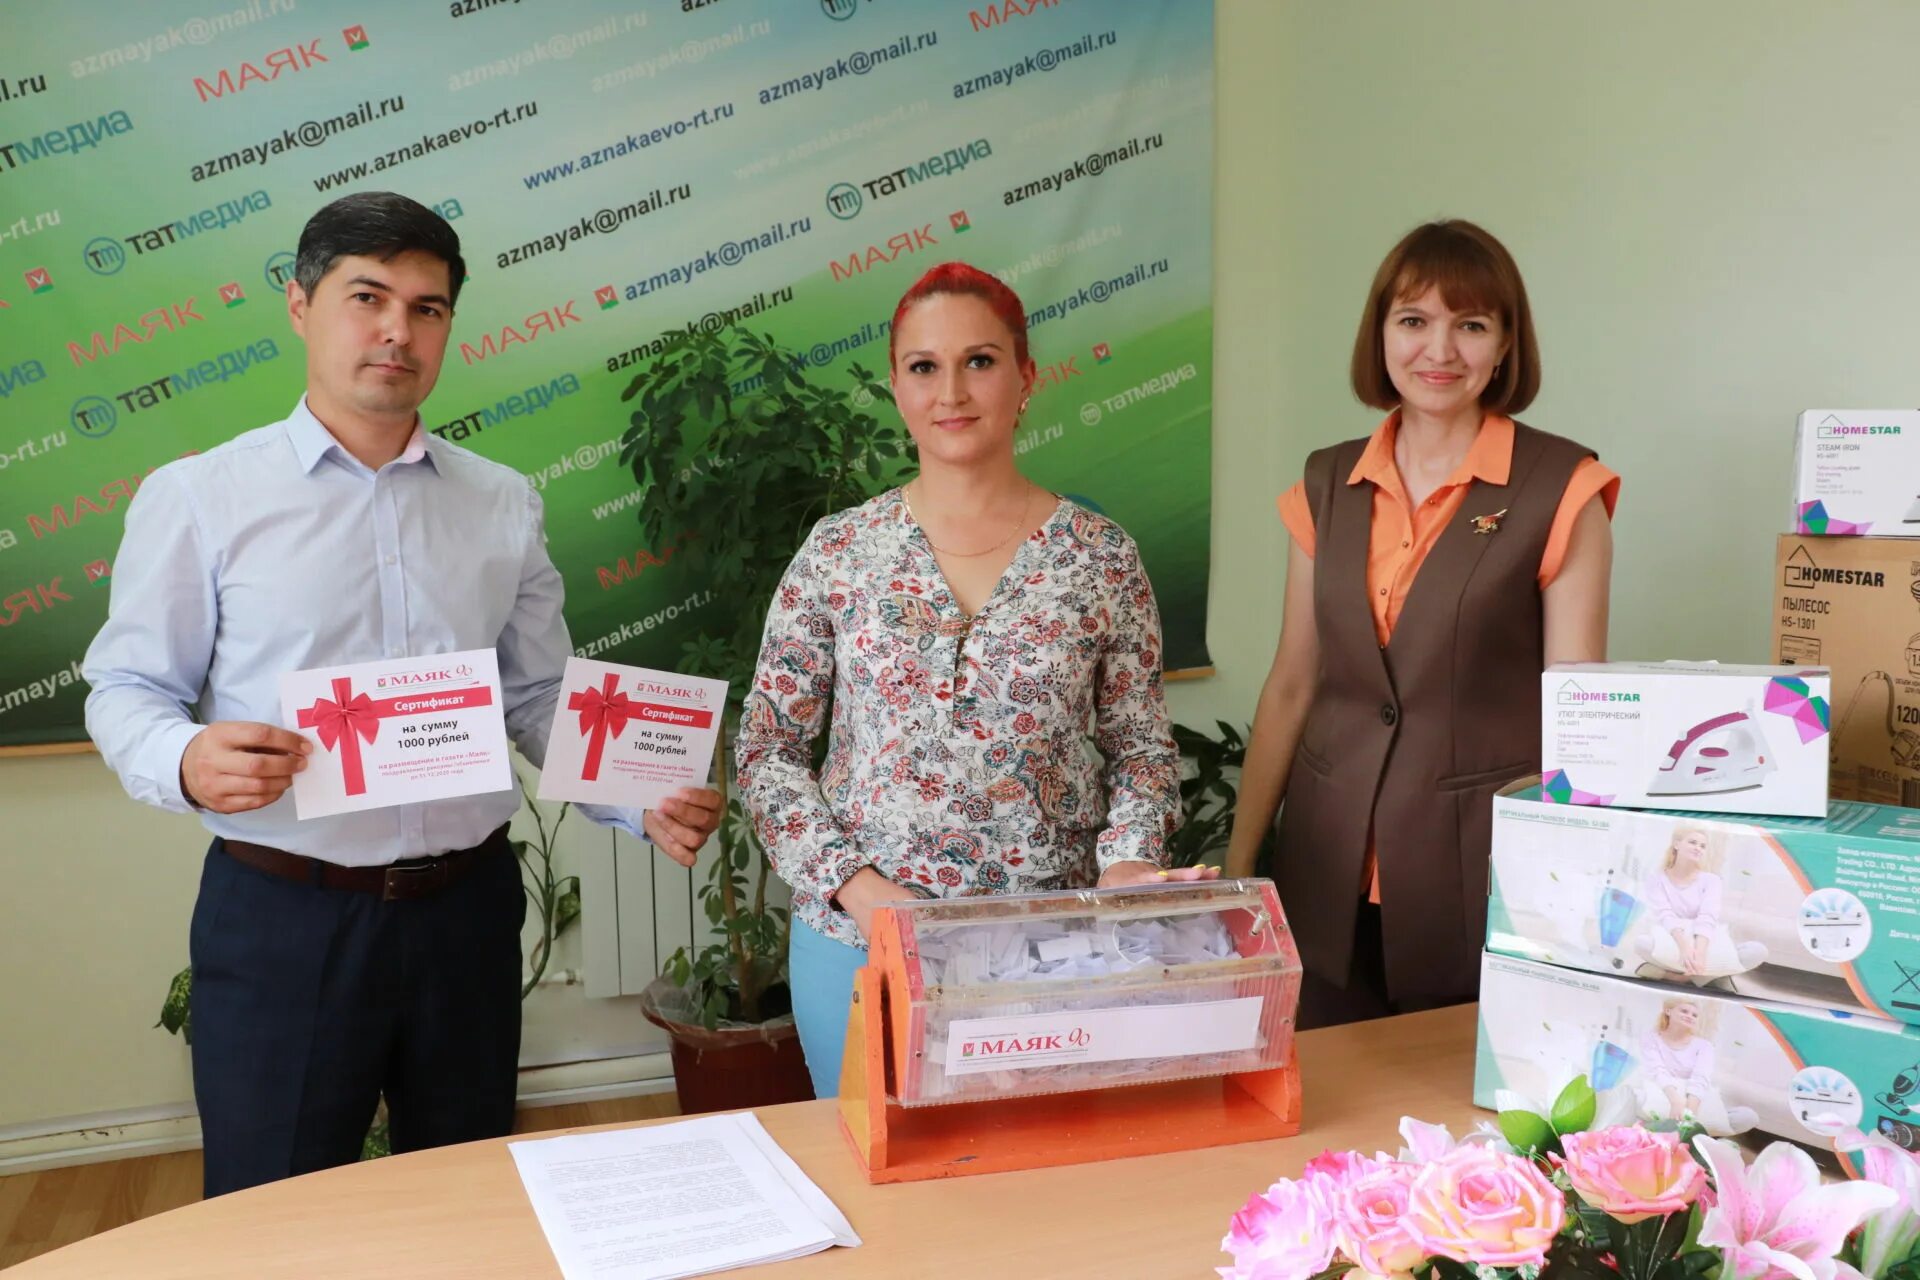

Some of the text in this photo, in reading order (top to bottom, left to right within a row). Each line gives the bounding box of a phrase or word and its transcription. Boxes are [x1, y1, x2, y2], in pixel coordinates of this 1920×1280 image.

[193, 38, 329, 102] МАЯК
[759, 31, 937, 104] azmayak@mail.ru
[953, 29, 1117, 99] azmayak@mail.ru
[191, 96, 404, 182] azmayak@mail.ru
[314, 101, 538, 192] www.aznakaevo-rt.ru
[523, 102, 734, 190] www.aznakaevo-rt.ru
[1003, 134, 1163, 207] azmayak@mail.ru
[496, 182, 692, 269] azmayak@mail.ru
[624, 217, 813, 301] azmayak@mail.ru
[829, 223, 939, 282] МАЯК
[66, 297, 205, 368] МАЯК
[460, 300, 582, 366] МАЯК
[1833, 426, 1901, 434] HOMESTAR
[1802, 567, 1885, 587] HOMESTAR
[1783, 597, 1831, 614] ПЫЛЕСОС
[1782, 616, 1816, 630] HS-1301
[392, 668, 452, 685] МАЯК
[648, 684, 692, 698] МАЯК
[1573, 692, 1640, 702] HOMESTAR
[394, 694, 465, 712] Сертификат
[642, 707, 694, 722] Сертификат
[1578, 710, 1641, 720] ЭЛЕКТРИЧЕСКИЙ
[402, 719, 458, 734] на сумму
[641, 730, 683, 742] на сумму
[397, 731, 470, 749] 1000 рублей
[634, 741, 687, 756] 1000 рублей
[981, 1035, 1062, 1055] МАЯК
